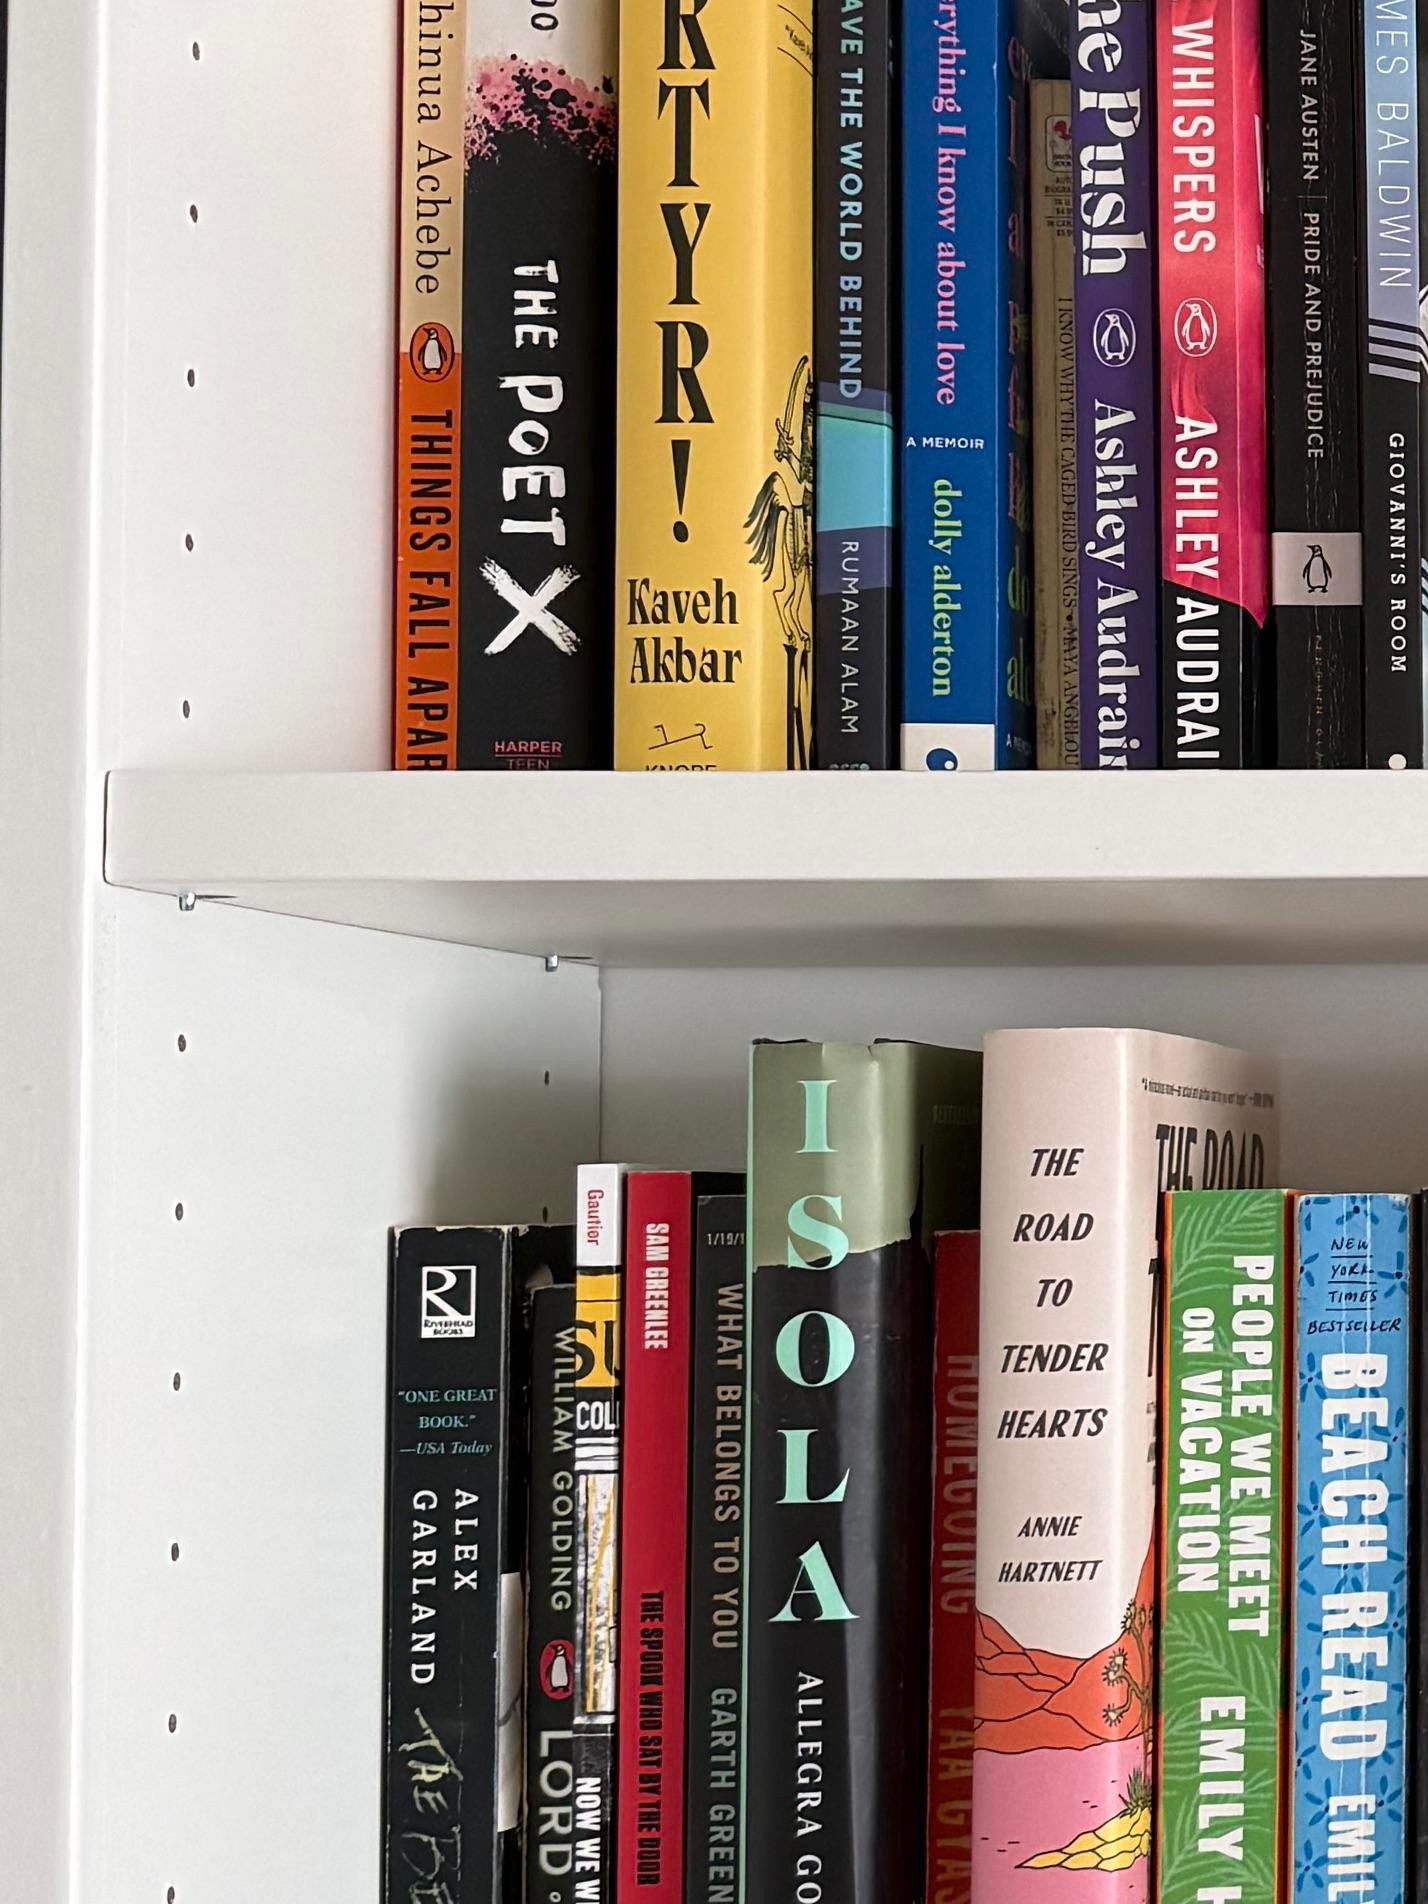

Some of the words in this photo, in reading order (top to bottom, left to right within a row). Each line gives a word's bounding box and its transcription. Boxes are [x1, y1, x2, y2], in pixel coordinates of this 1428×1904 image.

[1172, 19, 1215, 252] WHISPERS
[416, 146, 452, 293] Achebe
[514, 260, 558, 348] THE
[500, 376, 565, 545] POET
[907, 437, 916, 446] A
[923, 437, 984, 449] MEMOIR
[480, 556, 580, 655] X
[628, 578, 739, 625] Kaveh
[631, 637, 742, 683] Akbar
[495, 741, 561, 753] HARPER
[1031, 1149, 1084, 1176] THE
[587, 1190, 604, 1245] Gautier
[1013, 1213, 1093, 1242] ROAD
[1037, 1279, 1072, 1307] TO
[766, 1079, 861, 1626] ISOLA
[1001, 1344, 1108, 1373] TENDER
[997, 1409, 1107, 1438] HEARTS
[454, 1489, 478, 1590] ALEX
[1018, 1516, 1081, 1537] ANNIE
[411, 1490, 437, 1683] GARLAND
[999, 1560, 1102, 1582] HARTNETT
[797, 1672, 823, 1836] ALLEGRA
[1198, 1696, 1245, 1860] EMILY
